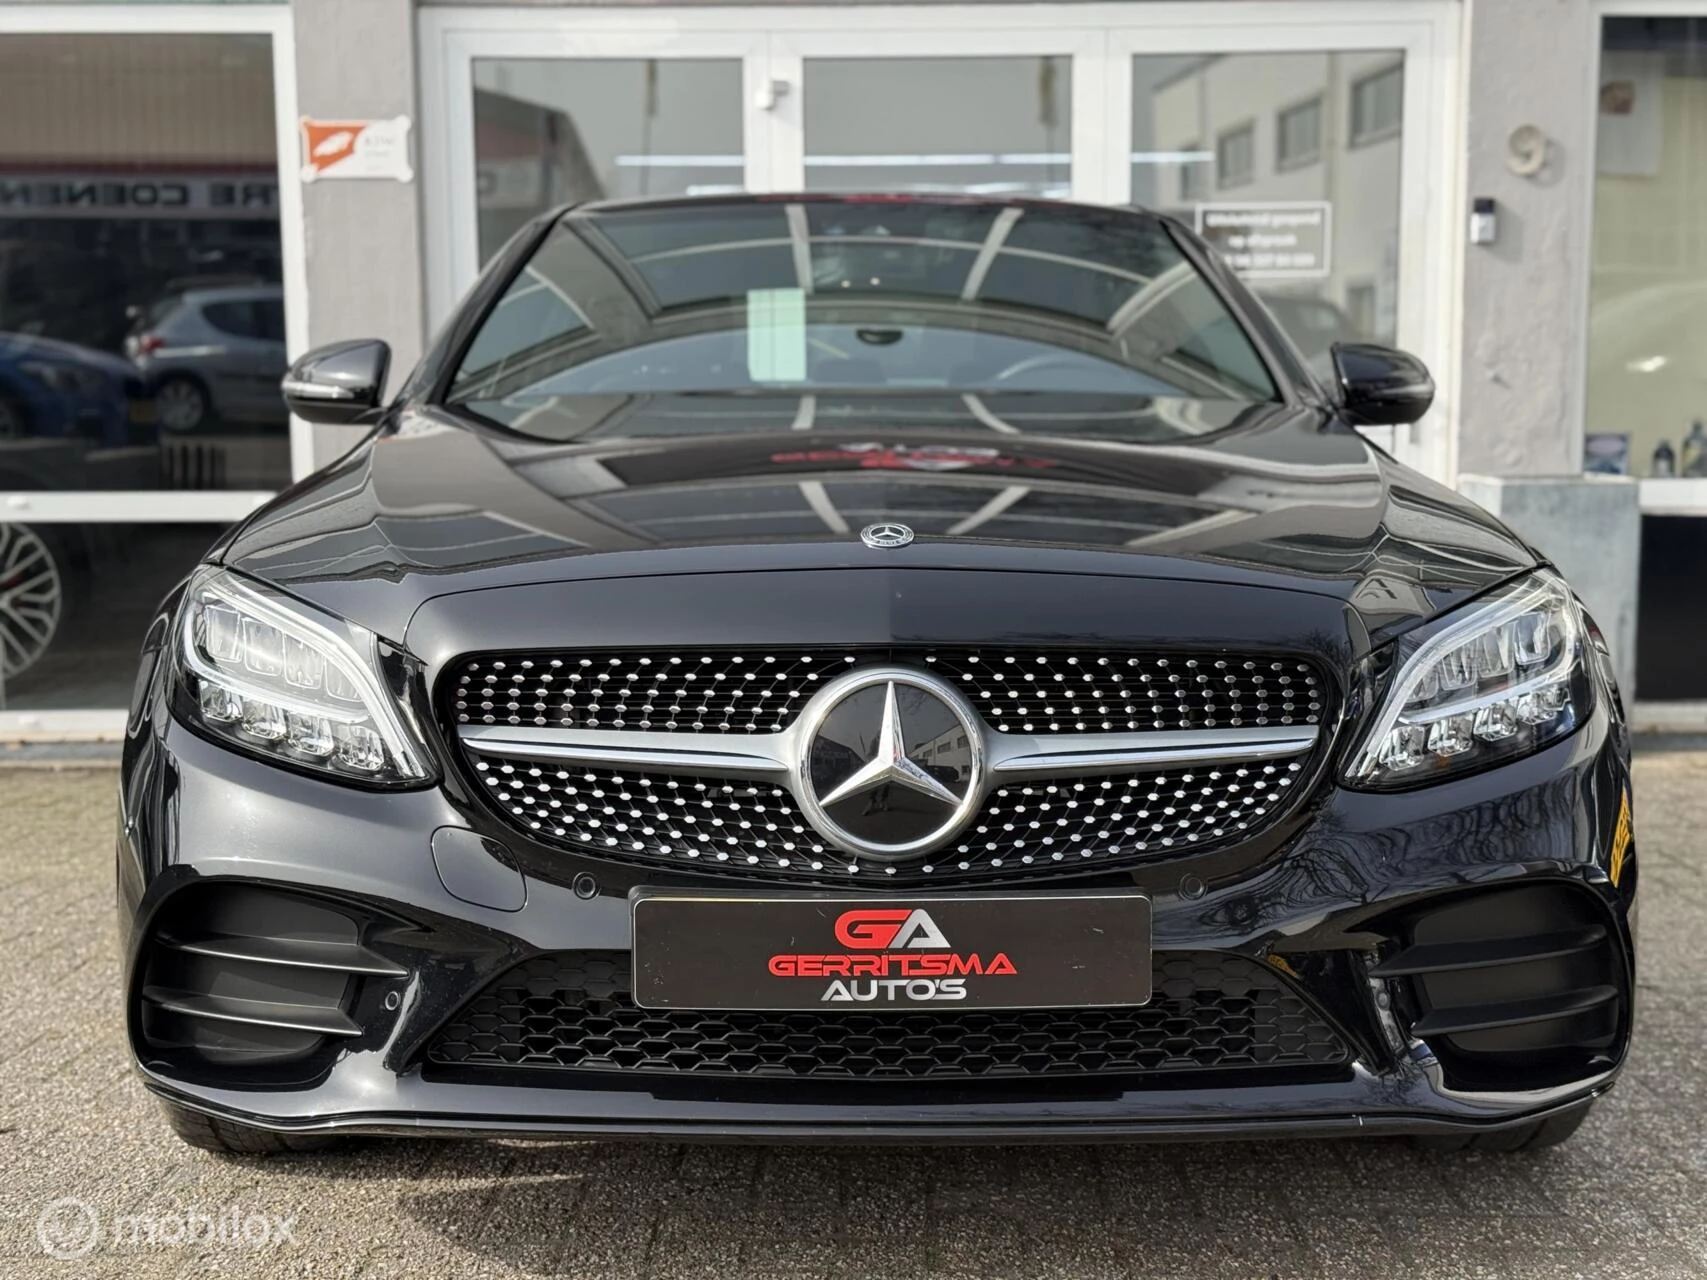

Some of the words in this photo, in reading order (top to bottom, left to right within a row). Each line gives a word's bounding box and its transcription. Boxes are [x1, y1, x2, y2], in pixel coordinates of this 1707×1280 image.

[834, 908, 950, 950] GA
[768, 953, 1018, 977] GERRITSMA
[821, 979, 967, 1003] AUTO'S
